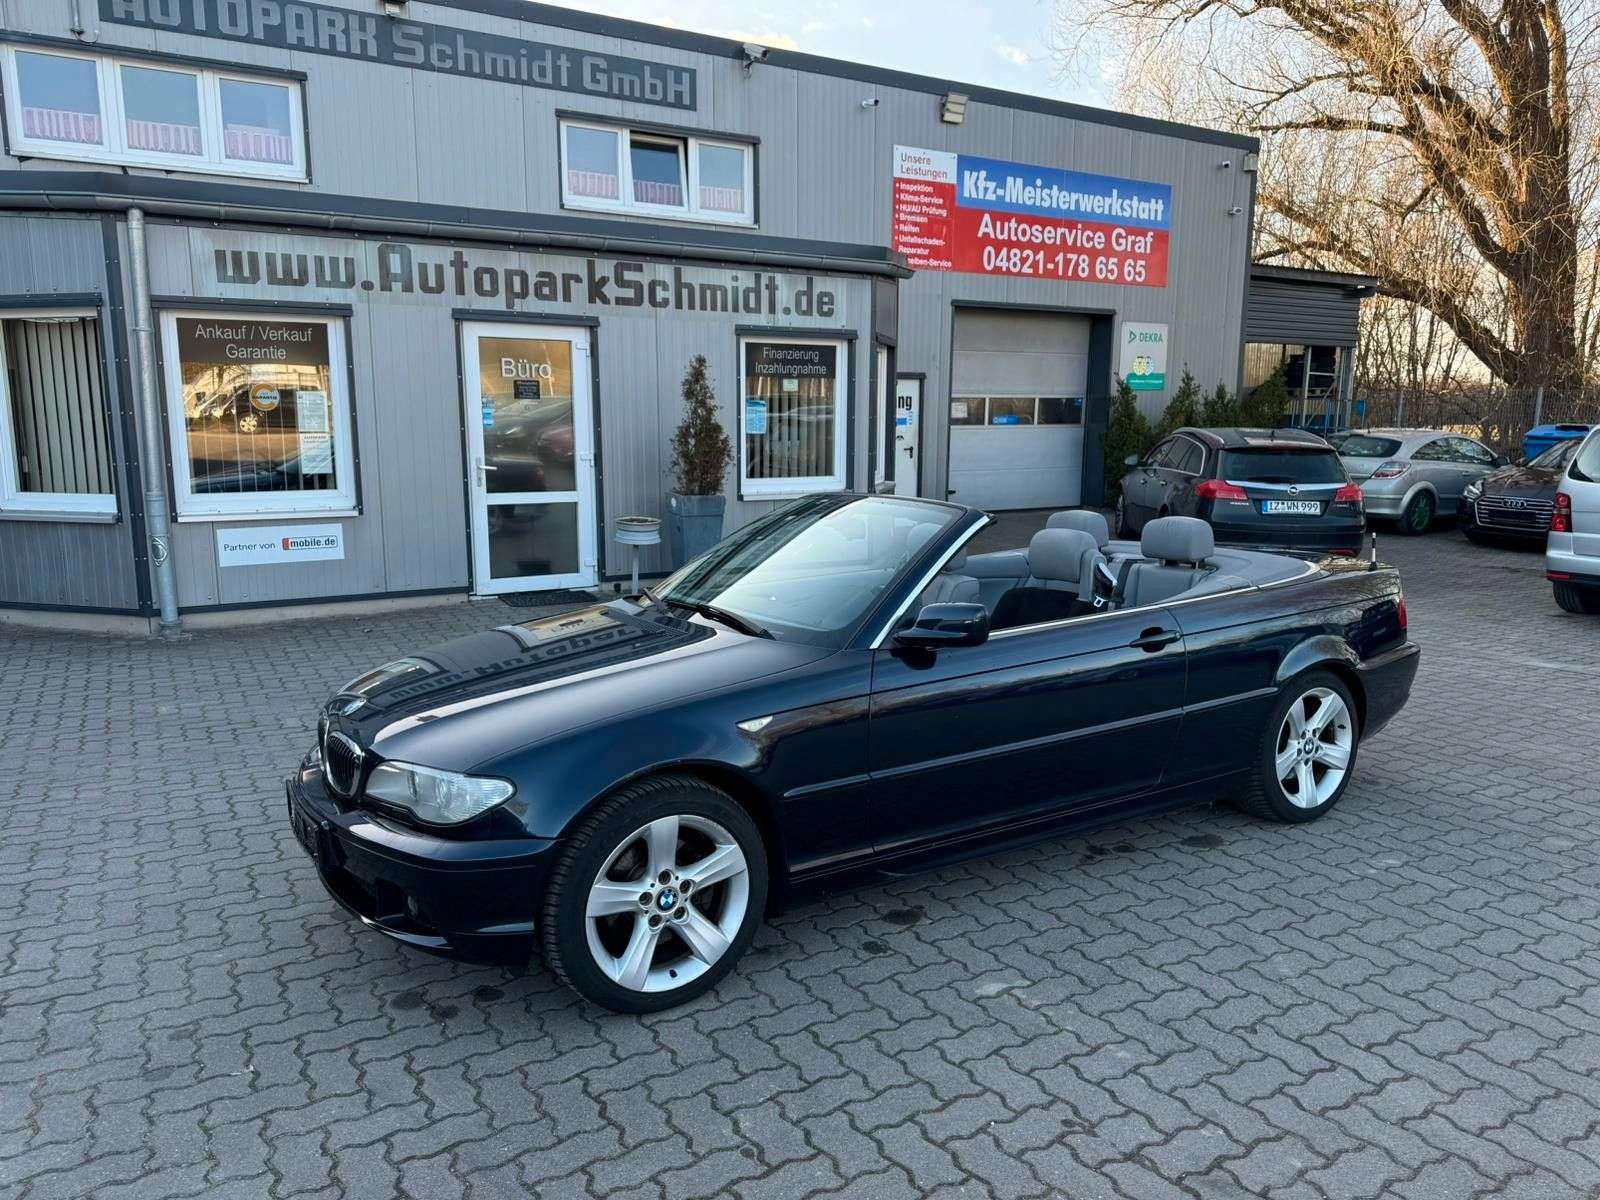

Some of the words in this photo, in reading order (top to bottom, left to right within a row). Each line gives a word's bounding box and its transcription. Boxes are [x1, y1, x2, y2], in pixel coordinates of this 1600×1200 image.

[392, 23, 571, 87] Schmidt
[583, 54, 690, 106] GmbH
[901, 152, 931, 165] Unsere
[901, 164, 947, 180] Leistungen
[963, 170, 1164, 221] Kfz-Meisterwerkstatt
[977, 213, 1105, 249] Autoservice
[1112, 227, 1154, 254] Graf
[982, 245, 1089, 278] 04821-178
[1096, 259, 1118, 280] 65
[1124, 261, 1146, 283] 65
[215, 243, 835, 318] www.AutoparkSchmidt.de
[195, 325, 247, 340] Ankauf
[250, 326, 256, 340] /
[258, 326, 313, 342] Verkauf
[1139, 332, 1163, 343] DEKRA
[225, 343, 288, 360] Garantie
[763, 347, 820, 362] Finanzierung
[501, 357, 552, 379] Büro
[755, 362, 827, 377] Inzahlungnahme
[1269, 501, 1279, 511] IZ
[1286, 502, 1299, 511] WN
[1301, 502, 1319, 512] 999
[223, 543, 257, 552] Partner
[260, 542, 276, 550] von
[290, 537, 336, 548] mobile.de
